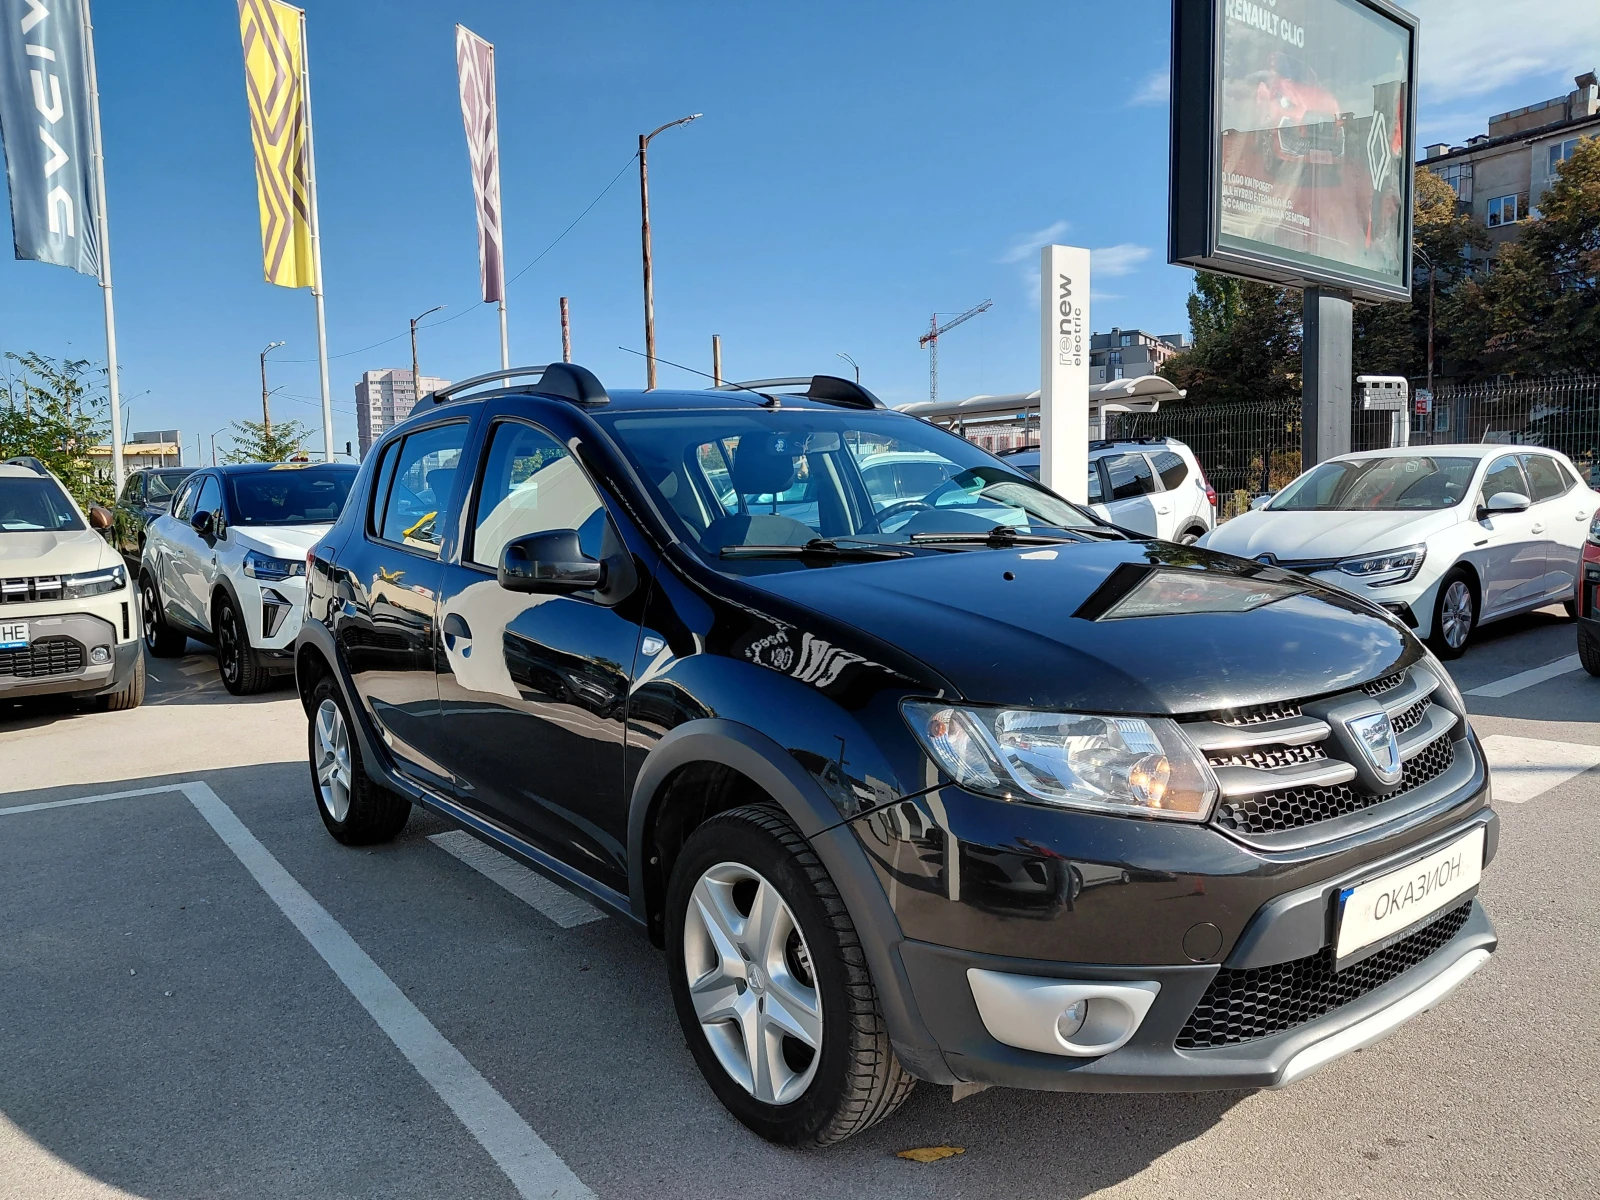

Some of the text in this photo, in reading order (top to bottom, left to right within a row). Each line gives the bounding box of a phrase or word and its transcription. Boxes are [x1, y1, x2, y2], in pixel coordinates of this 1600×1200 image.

[1226, 0, 1304, 48] RENAULT CLIO
[1233, 186, 1253, 201] HYBRID
[1059, 273, 1072, 366] renew
[1073, 307, 1081, 366] electric
[1374, 853, 1461, 920] ОКАЗИОН
